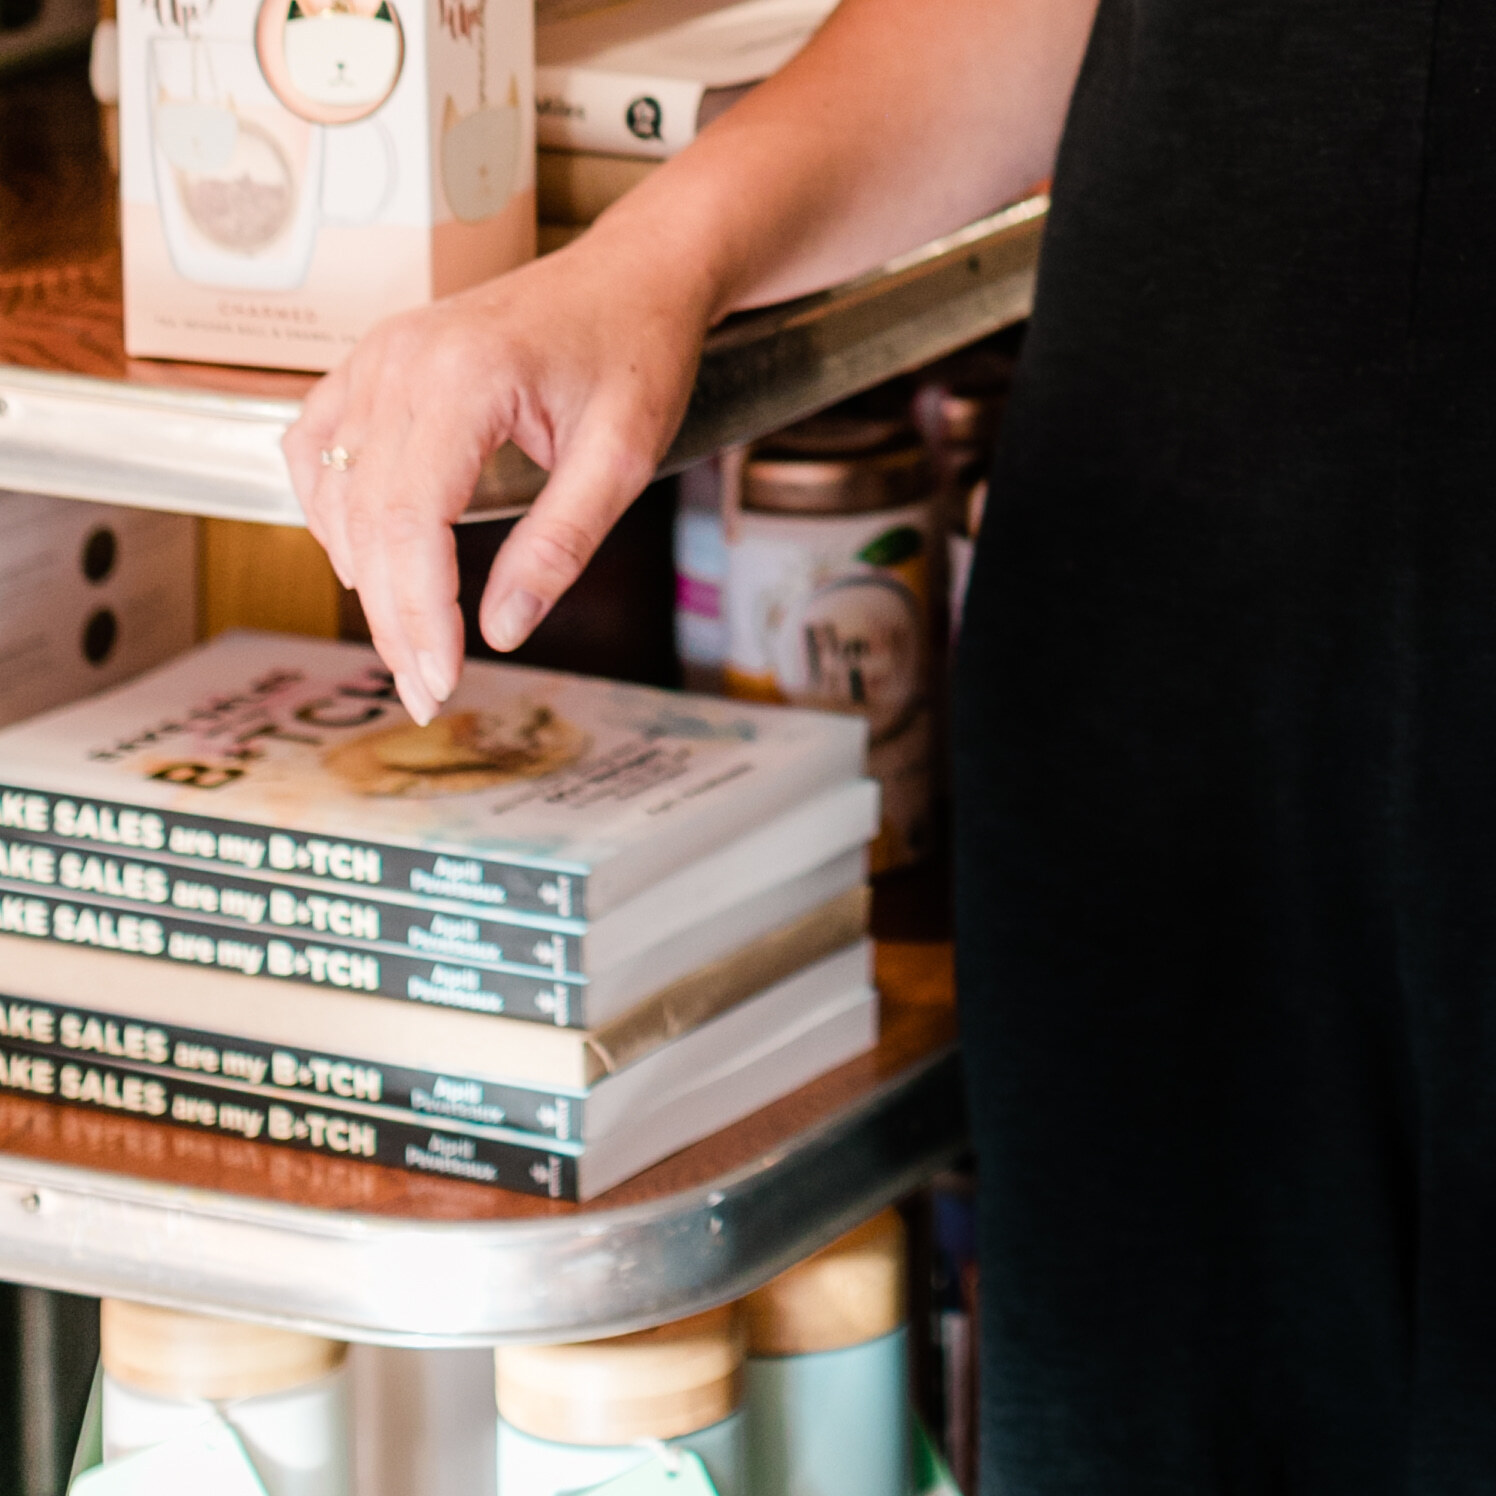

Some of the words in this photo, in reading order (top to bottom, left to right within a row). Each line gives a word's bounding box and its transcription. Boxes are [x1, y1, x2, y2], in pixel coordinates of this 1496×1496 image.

[53, 799, 166, 850] SALES
[168, 826, 218, 858] are
[217, 833, 267, 869] my
[58, 852, 170, 904] SALES
[171, 879, 219, 913] are
[219, 888, 268, 925] my
[53, 904, 166, 955] SALES
[167, 931, 217, 964] are
[216, 939, 265, 976] my
[60, 1012, 171, 1064] SALES
[174, 1041, 220, 1073] are
[221, 1049, 268, 1086] my
[59, 1063, 168, 1116] SALES
[171, 1093, 218, 1126] are
[218, 1102, 264, 1139] my
